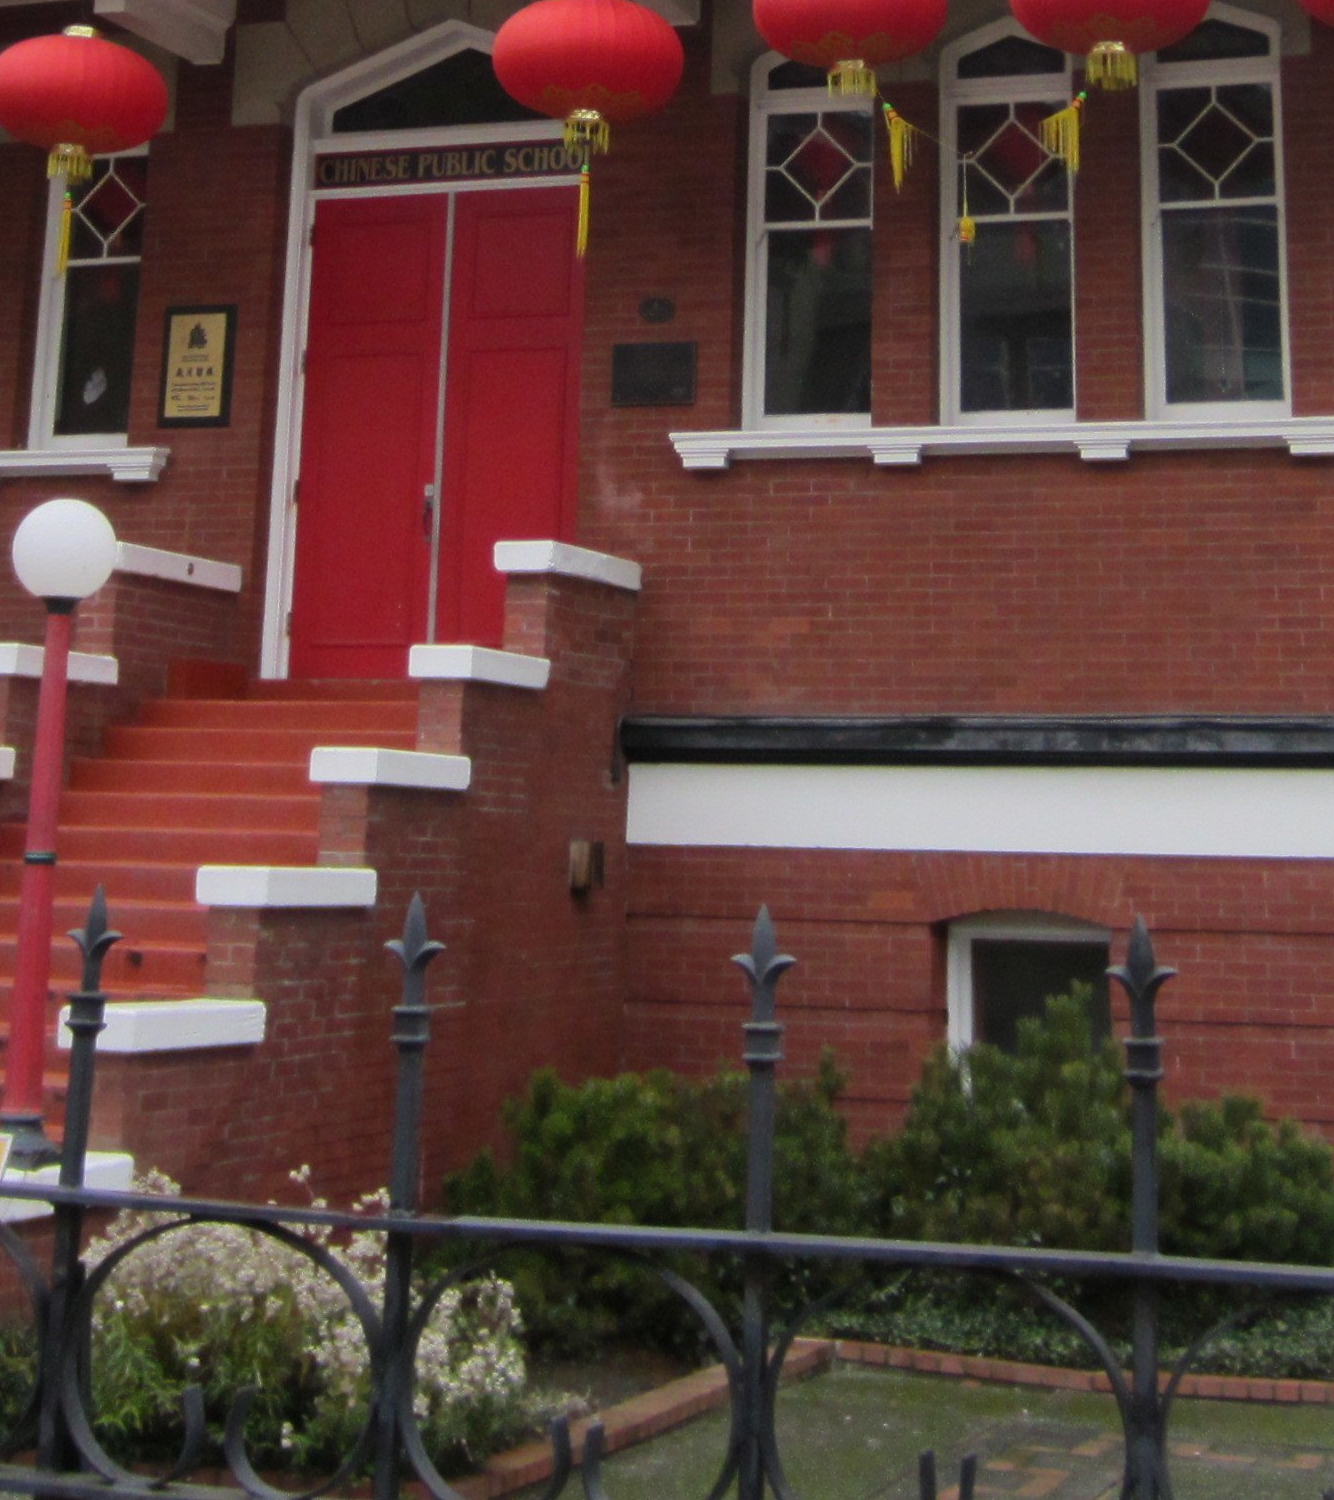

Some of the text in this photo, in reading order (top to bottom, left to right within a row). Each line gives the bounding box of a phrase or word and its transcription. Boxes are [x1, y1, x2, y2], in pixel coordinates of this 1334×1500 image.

[319, 143, 590, 184] CHINESE PUBLIC SCHOO
